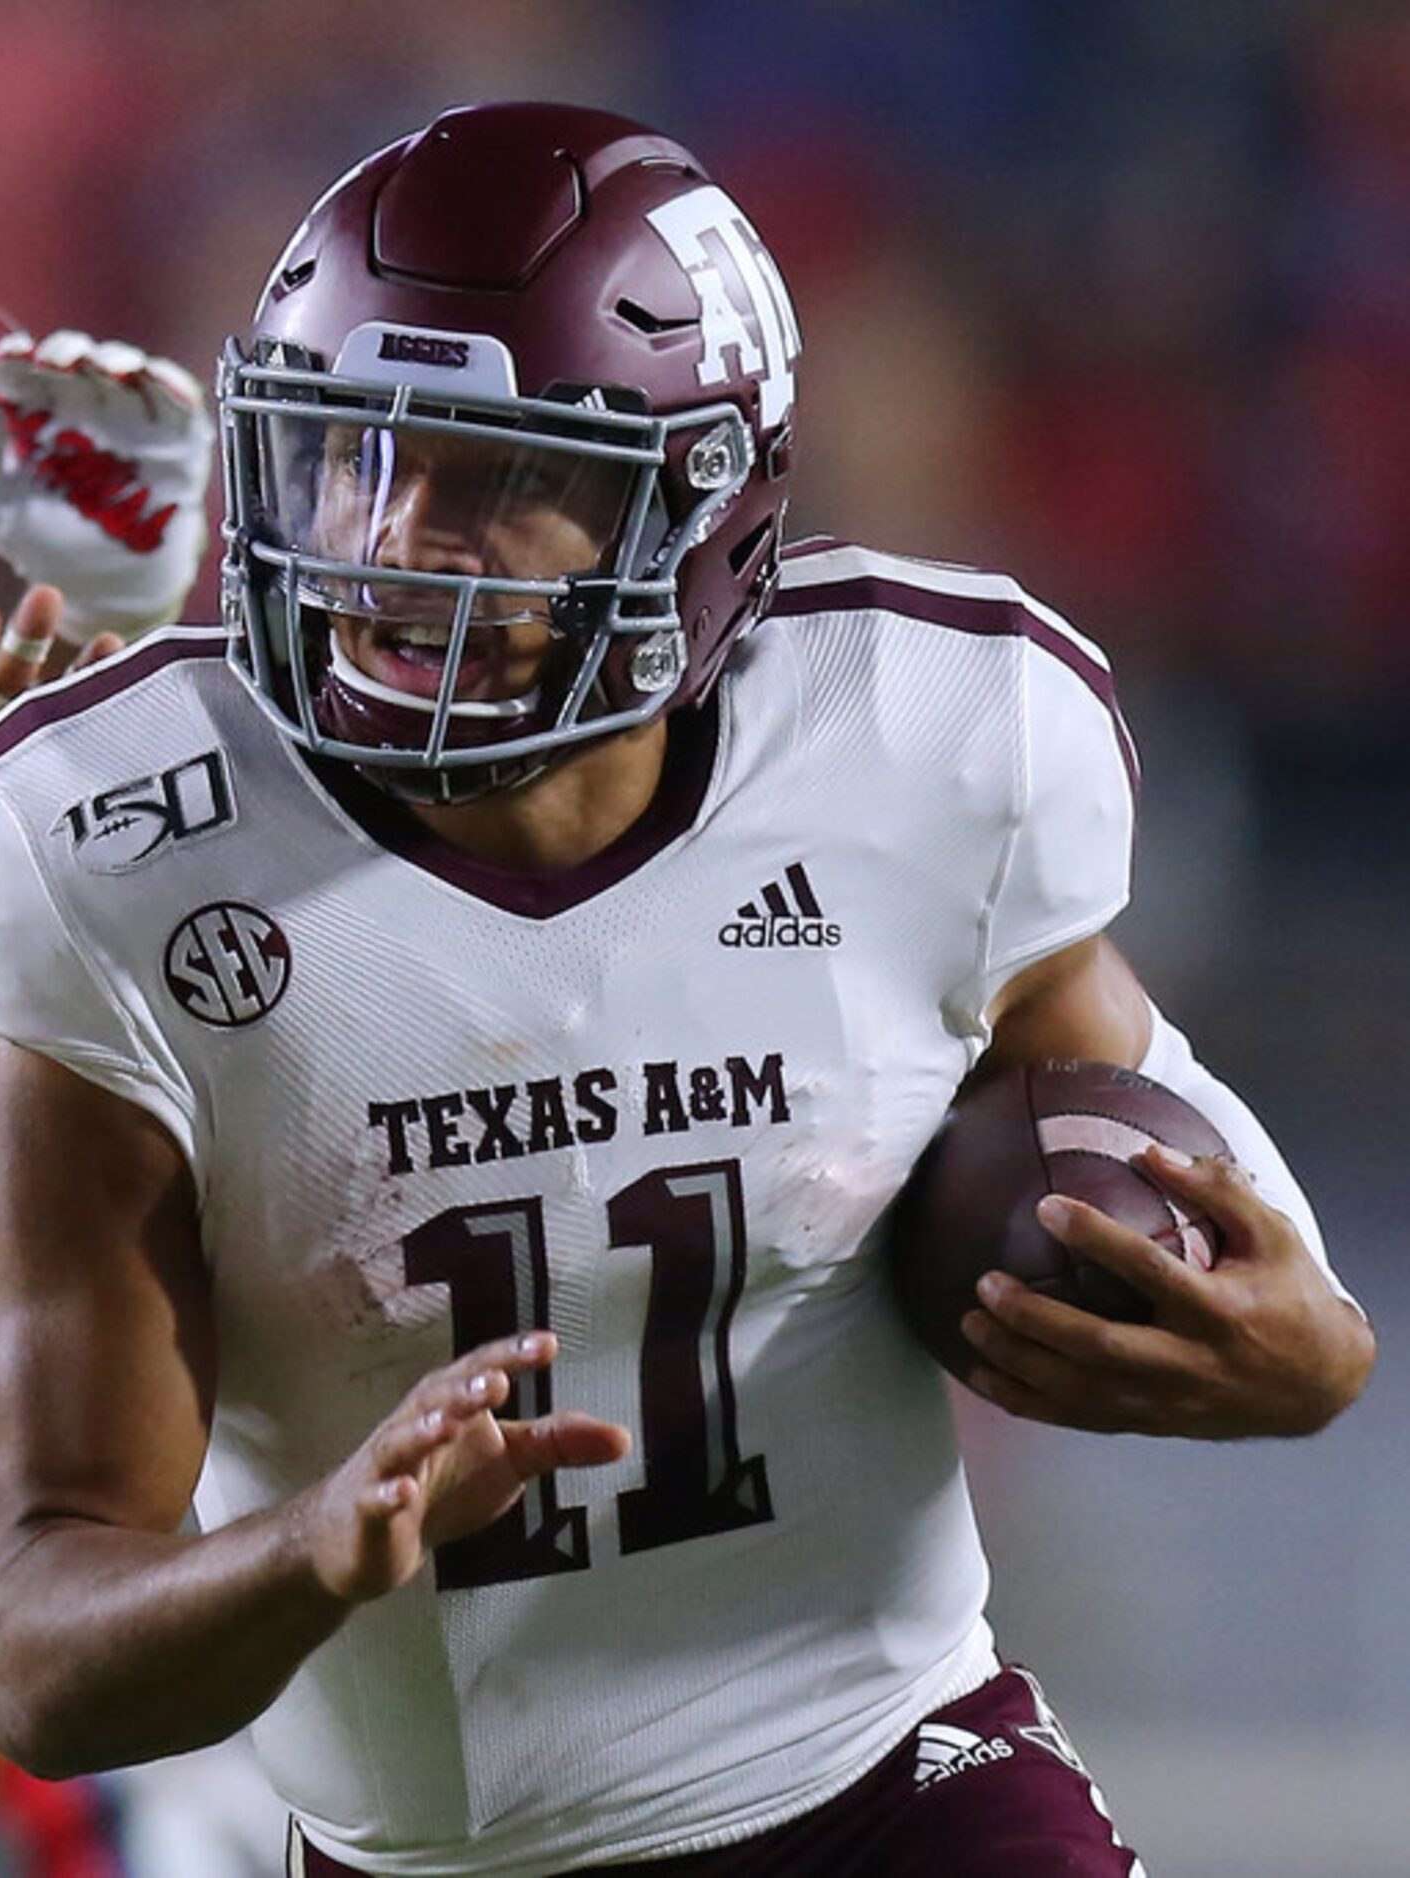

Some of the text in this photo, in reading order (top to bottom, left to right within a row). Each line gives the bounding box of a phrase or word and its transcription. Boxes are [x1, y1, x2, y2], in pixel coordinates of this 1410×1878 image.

[48, 746, 239, 875] 150
[166, 902, 291, 1027] SEC
[718, 915, 842, 948] adidas
[368, 1053, 790, 1175] TEXAS A&M
[402, 1158, 775, 1594] 11
